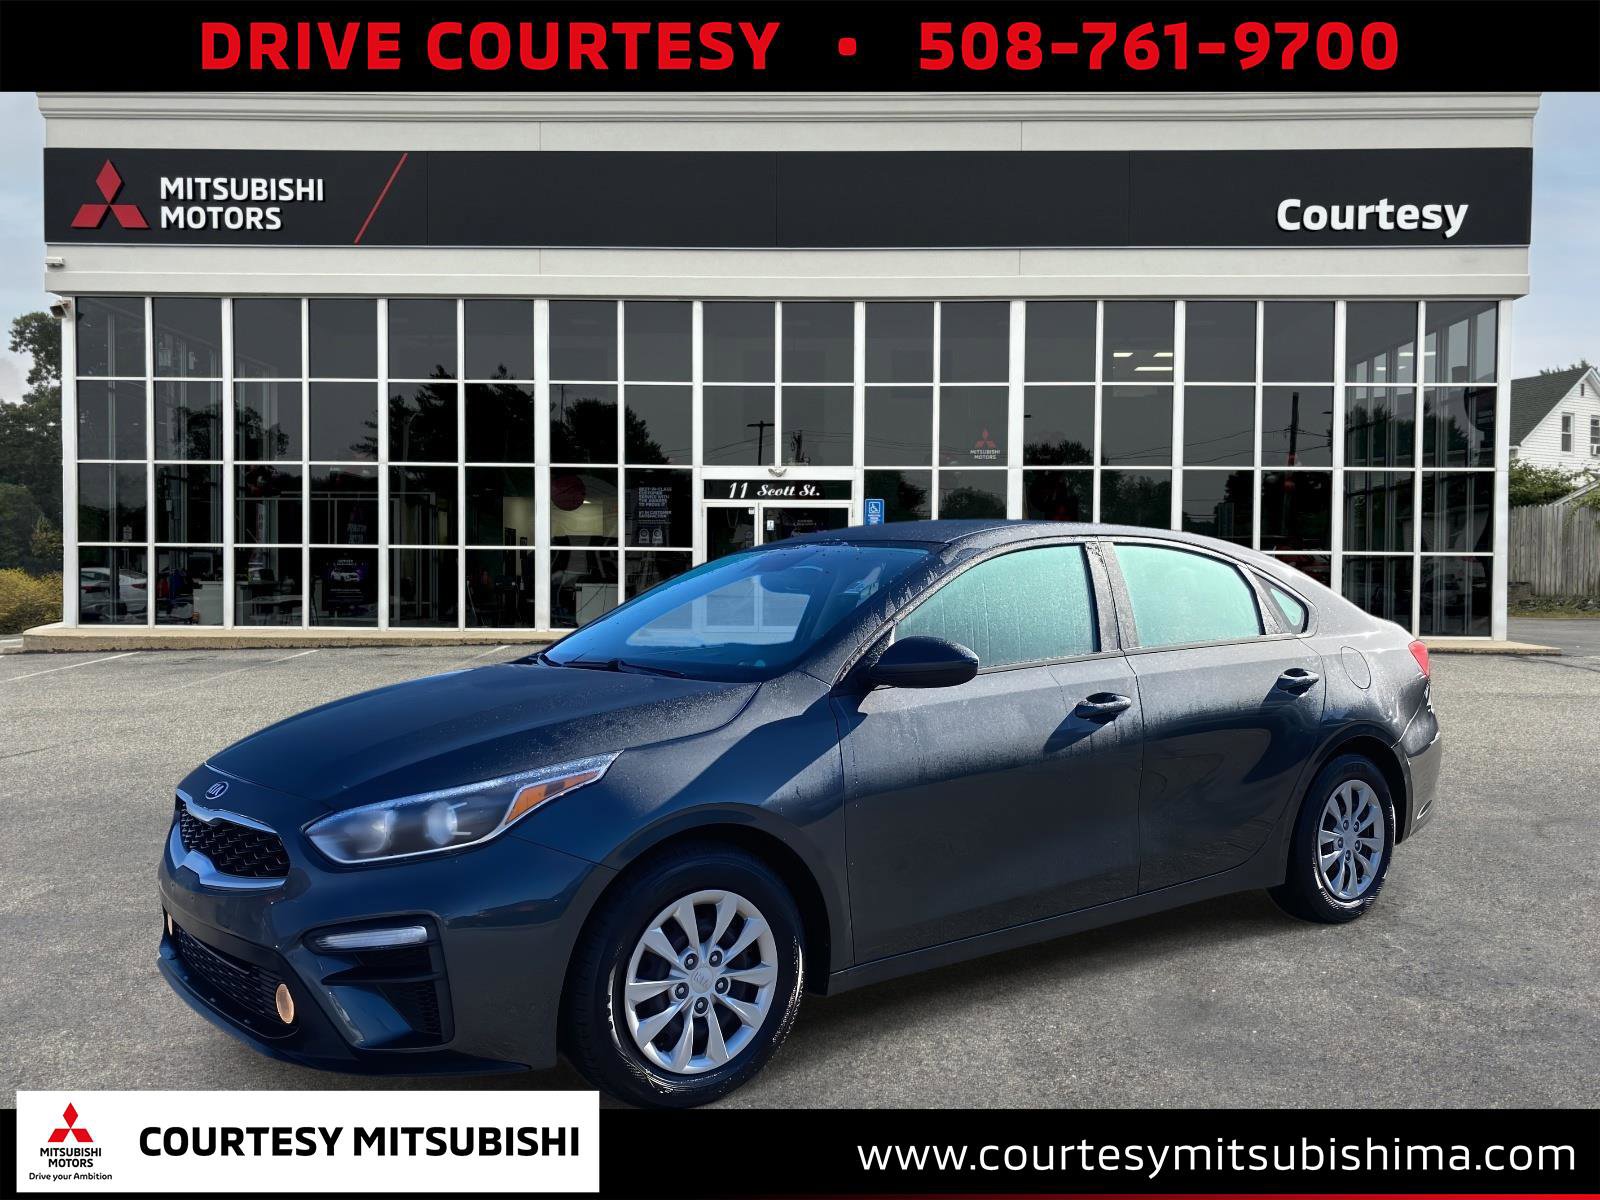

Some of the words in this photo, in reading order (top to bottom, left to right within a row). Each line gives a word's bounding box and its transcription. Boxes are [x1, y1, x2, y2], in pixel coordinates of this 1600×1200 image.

[160, 176, 325, 202] MITSUBISHI
[160, 205, 283, 231] MOTORS
[1277, 197, 1469, 239] Courtesy
[729, 482, 748, 499] 11
[756, 484, 796, 497] Scott
[798, 484, 820, 497] St.
